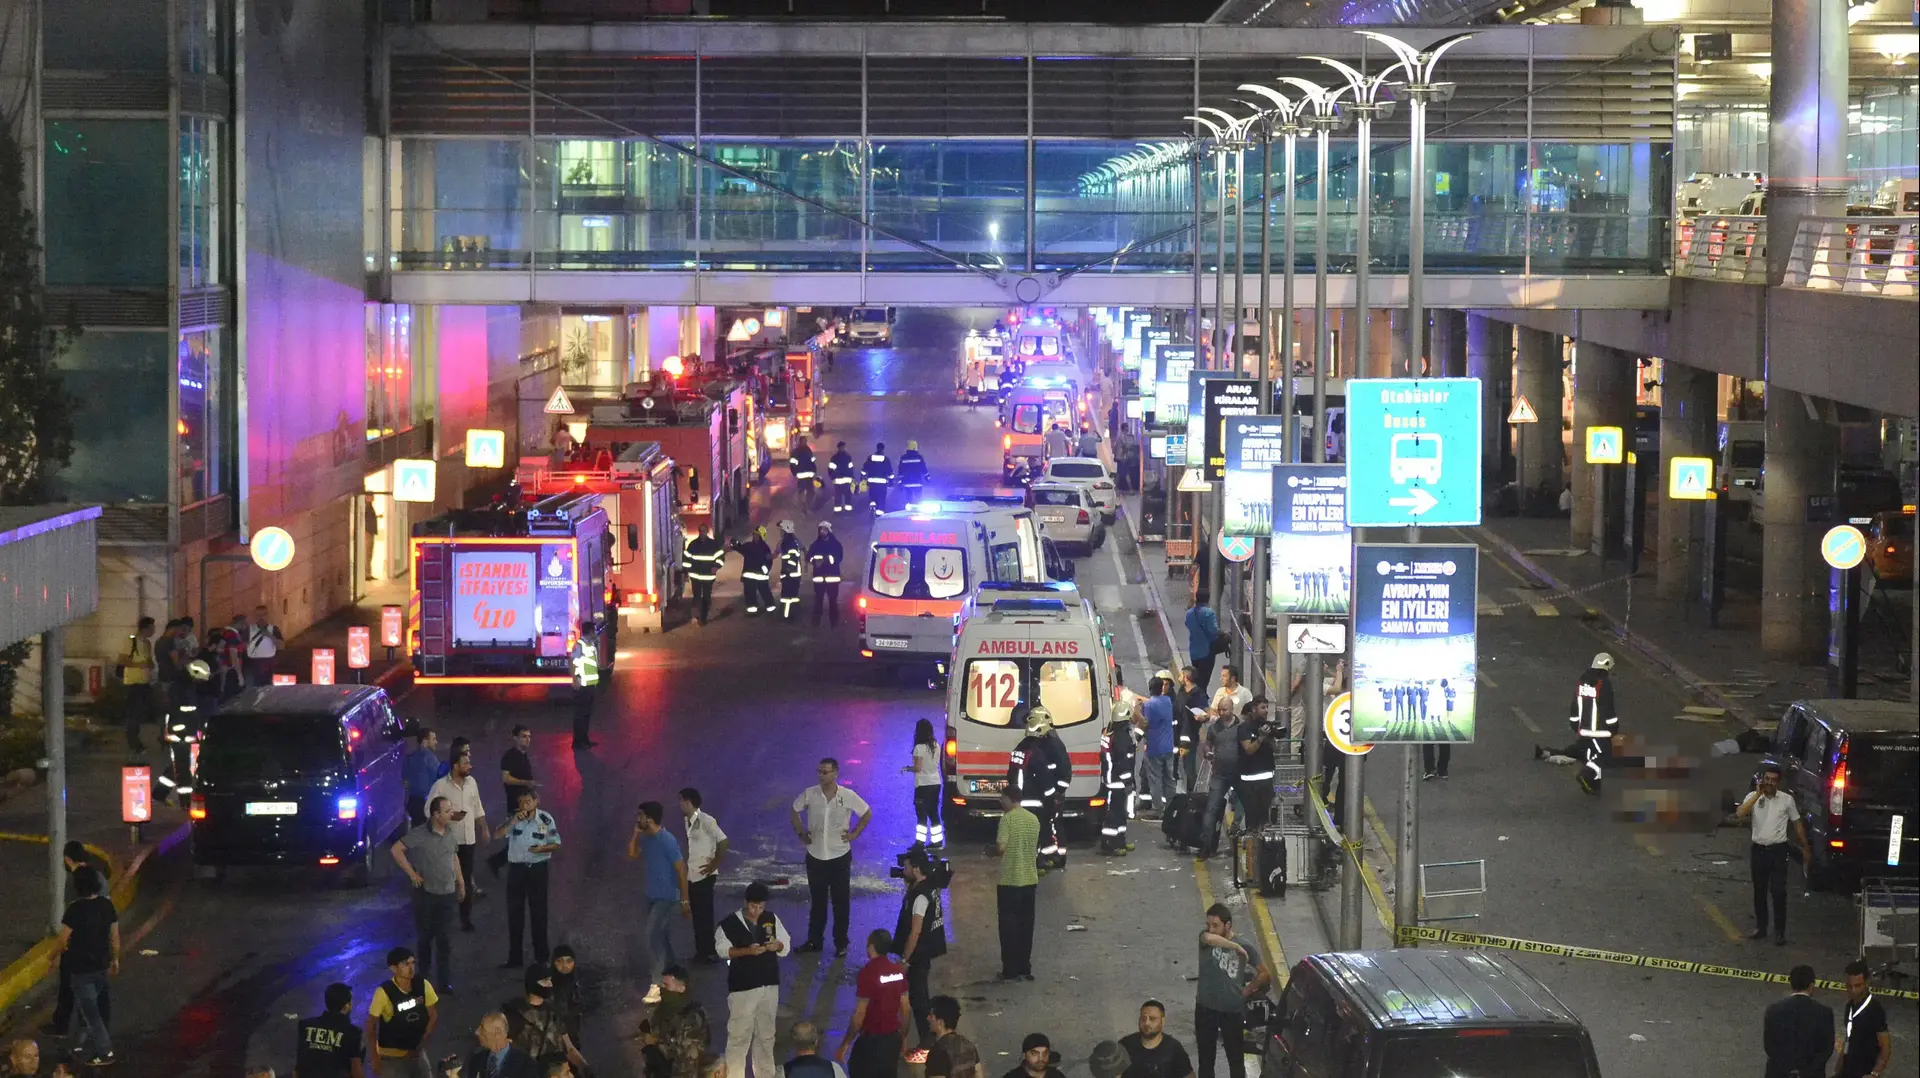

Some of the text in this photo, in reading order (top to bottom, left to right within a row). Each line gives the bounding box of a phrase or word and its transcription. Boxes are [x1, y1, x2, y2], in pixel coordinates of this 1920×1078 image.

[1226, 385, 1252, 395] ARAÇ
[1214, 395, 1259, 405] KİRALAM
[1291, 506, 1307, 521] EN
[879, 532, 956, 544] AMBULANS
[886, 563, 905, 575] 112
[1382, 583, 1450, 599] AVRUPA'NIN
[1381, 600, 1400, 619] EN
[480, 608, 517, 629] 110
[1381, 621, 1449, 635] SAHAYA ÇIKIYOR
[978, 640, 1078, 655] AMBULANS
[971, 673, 1016, 708] 112
[1339, 710, 1351, 736] 3
[305, 1027, 344, 1048] TEM
